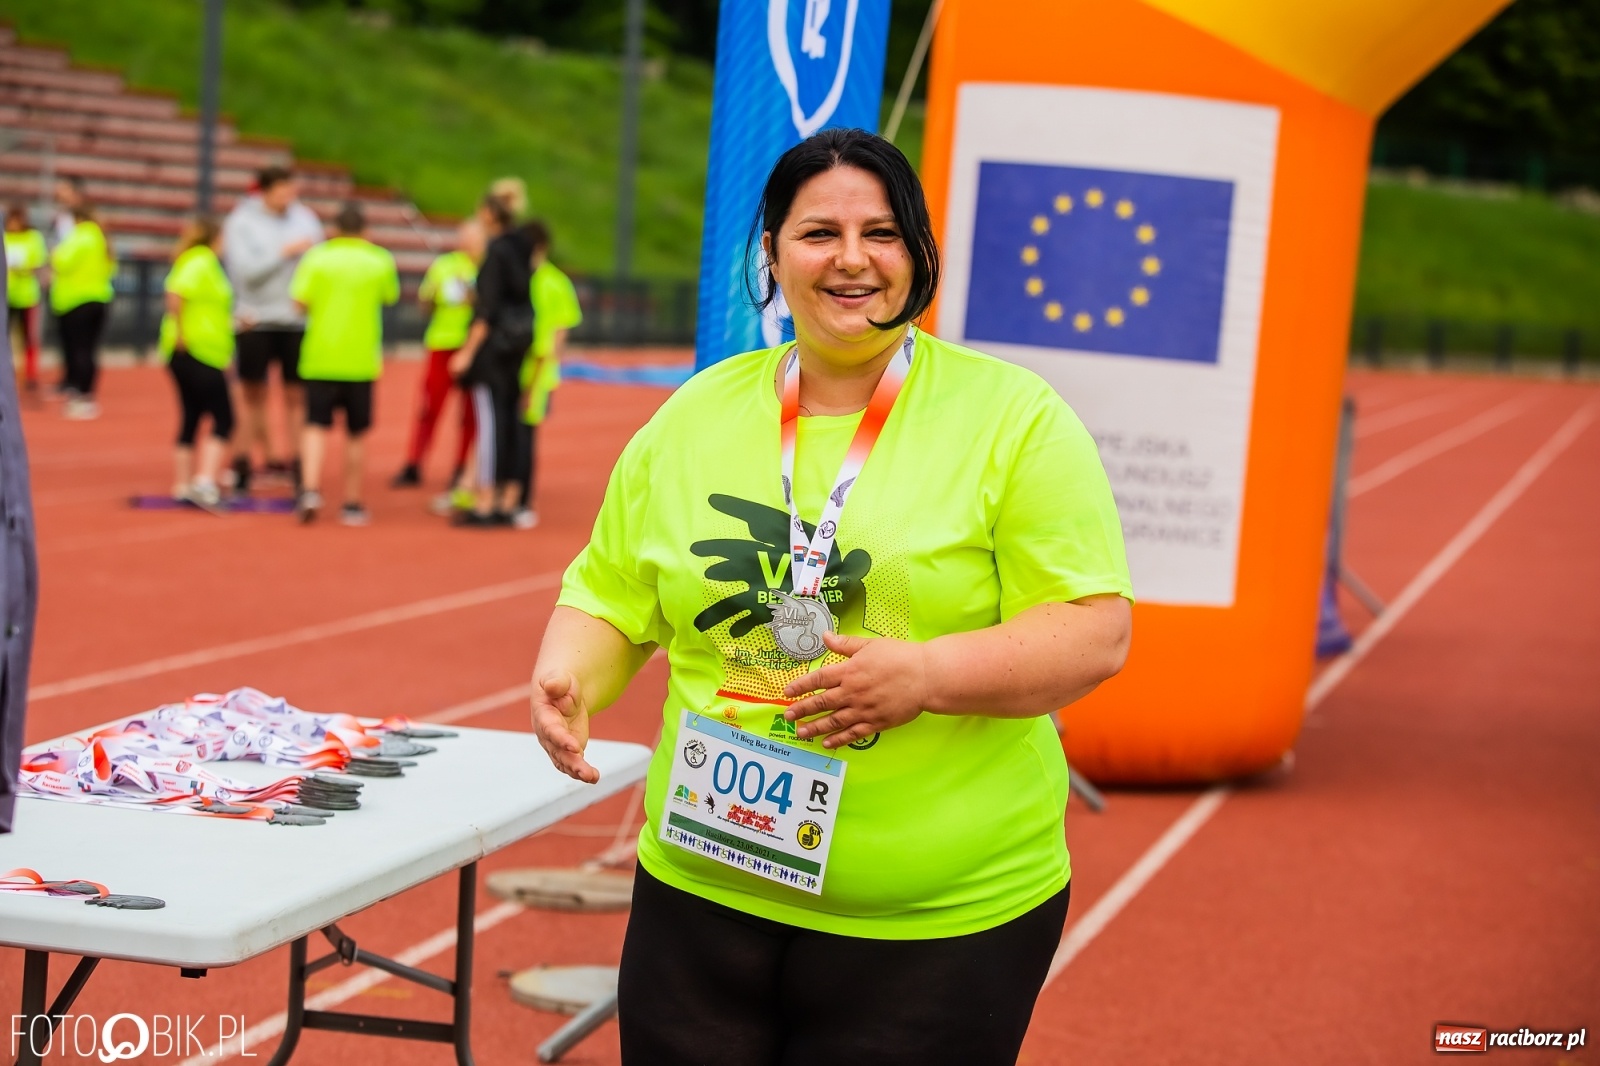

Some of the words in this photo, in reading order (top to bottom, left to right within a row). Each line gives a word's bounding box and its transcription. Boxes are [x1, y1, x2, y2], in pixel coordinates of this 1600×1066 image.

[730, 730, 739, 740] VI
[740, 734, 755, 747] Bieg
[755, 740, 768, 750] Bez
[768, 744, 792, 757] Barier
[713, 751, 794, 815] 004
[809, 779, 829, 806] R
[736, 840, 770, 858] 23.05.2021
